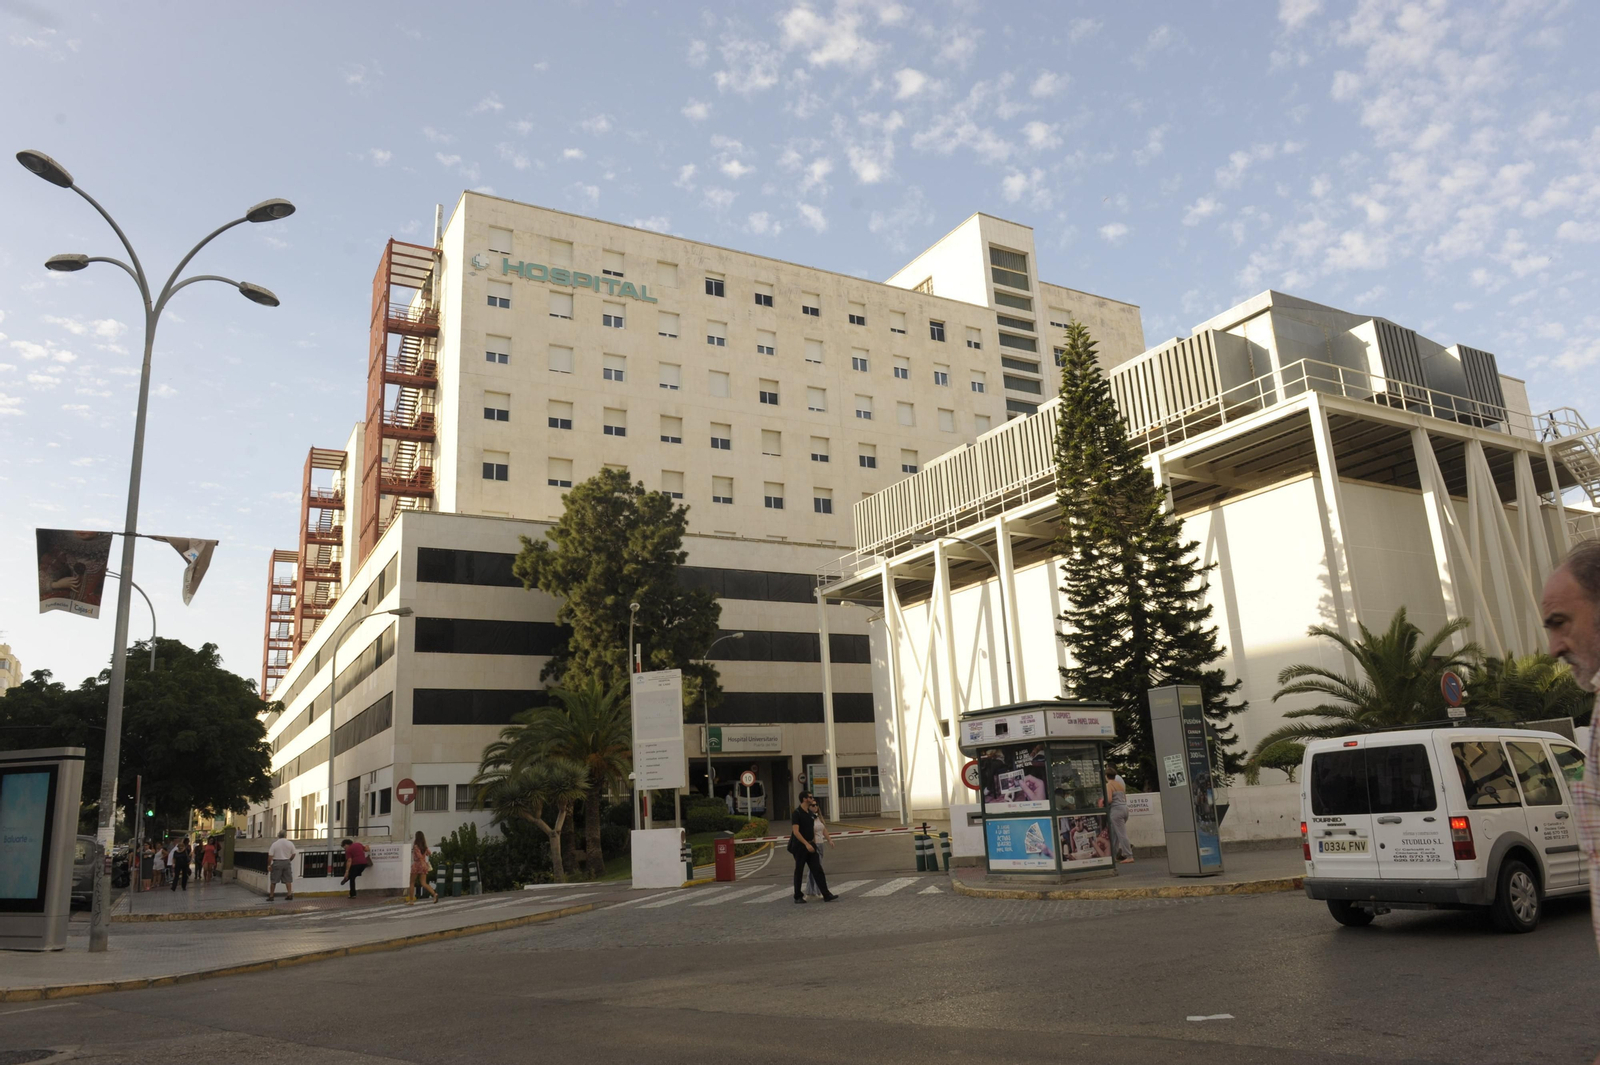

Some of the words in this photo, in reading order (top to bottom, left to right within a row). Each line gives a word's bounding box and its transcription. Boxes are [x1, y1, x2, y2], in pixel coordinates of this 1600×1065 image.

[502, 257, 658, 304] HOSPITAL
[74, 604, 93, 614] Cajasol
[4, 835, 27, 843] Baluarte
[1324, 841, 1346, 851] 0334
[1348, 841, 1366, 851] FNV
